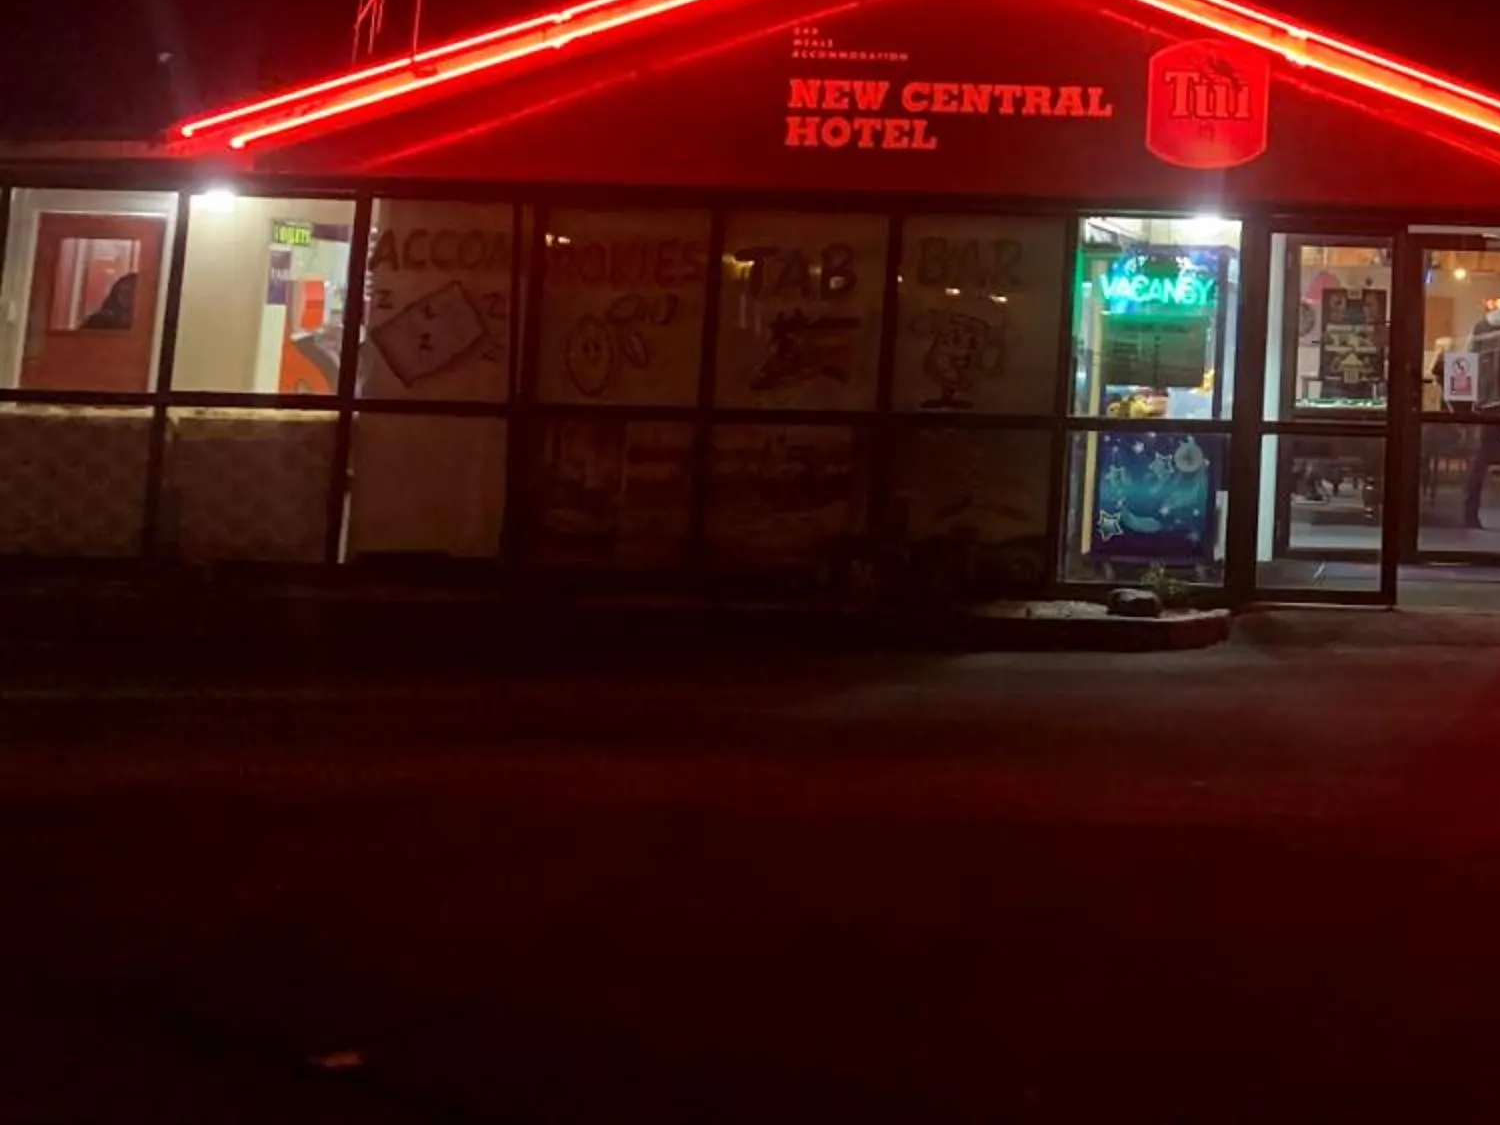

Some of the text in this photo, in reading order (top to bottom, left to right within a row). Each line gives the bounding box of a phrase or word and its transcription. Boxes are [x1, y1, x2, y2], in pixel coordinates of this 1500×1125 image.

[786, 78, 1113, 118] NEW CENTRAL
[784, 116, 937, 150] HOTEL
[735, 244, 858, 299] TAB
[918, 236, 1023, 288] BAR
[1100, 274, 1215, 306] VACANCY
